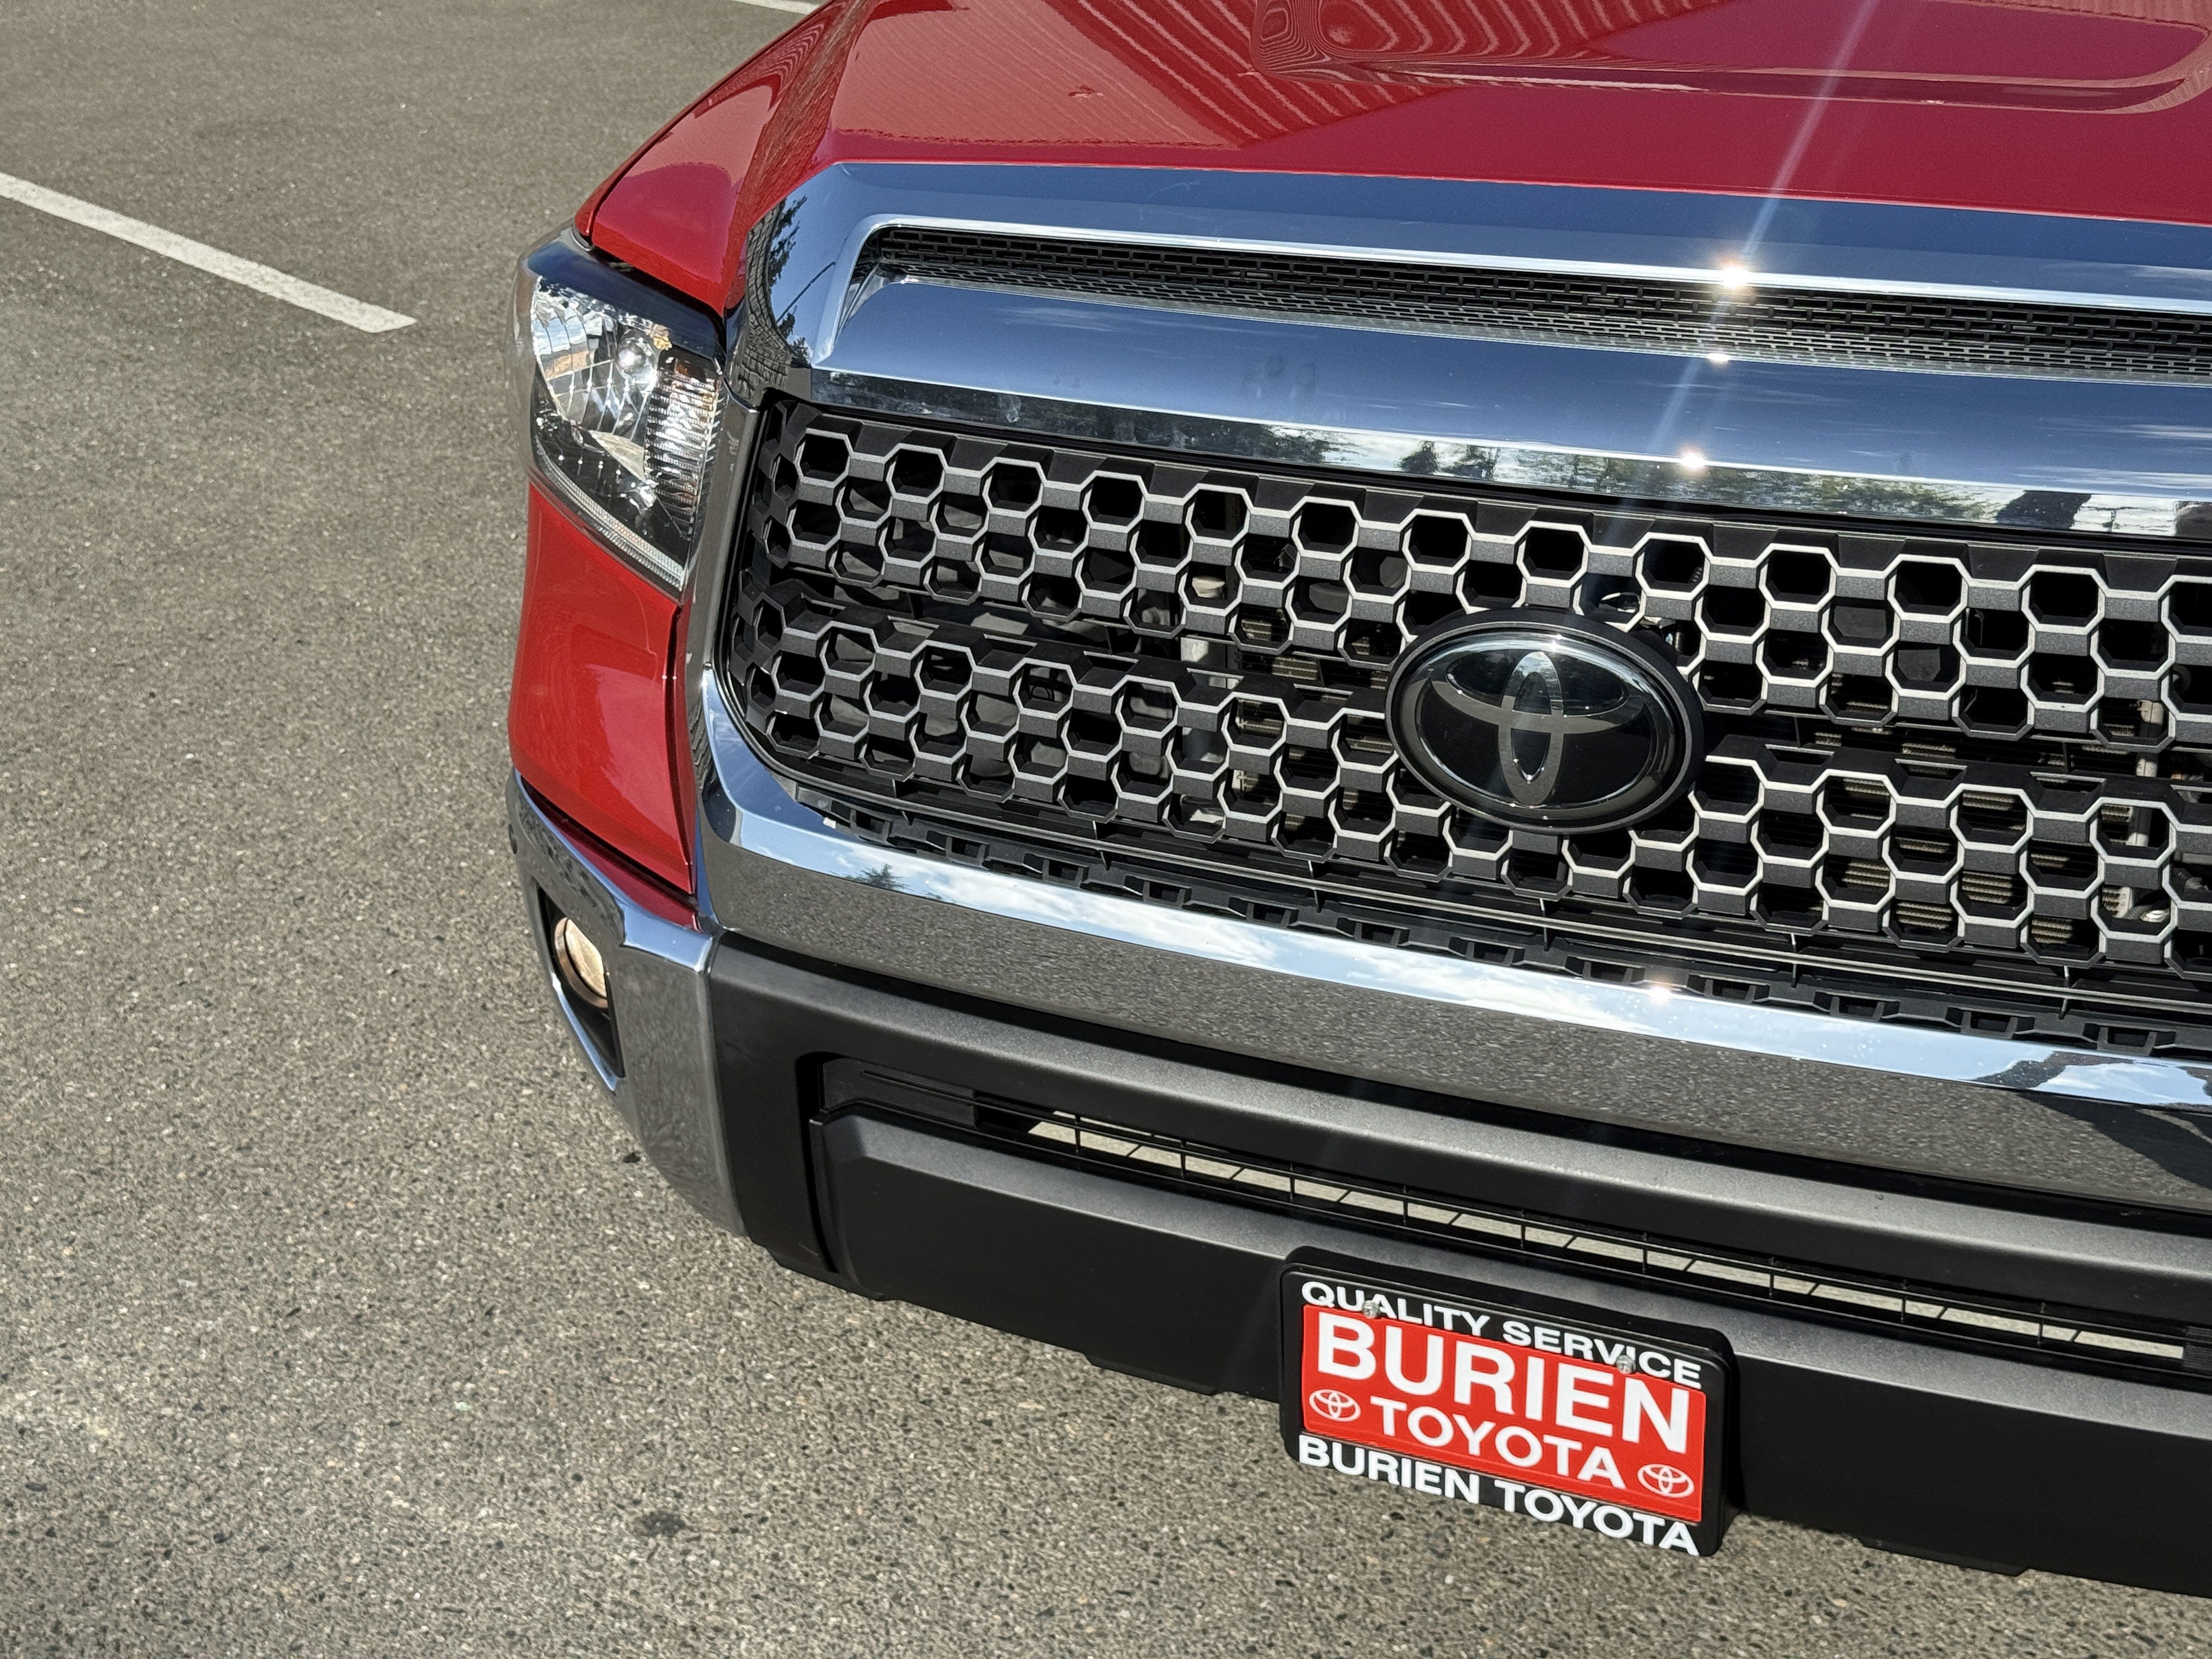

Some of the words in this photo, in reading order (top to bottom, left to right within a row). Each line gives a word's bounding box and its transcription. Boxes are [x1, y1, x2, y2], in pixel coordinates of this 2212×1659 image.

[1302, 1282, 1489, 1336] QUALITY
[1318, 1312, 1689, 1454] BURIEN
[1300, 1435, 1479, 1504] BURIEN
[1494, 1480, 1699, 1556] TOYOTA
[1371, 1397, 1626, 1489] TOYOTA
